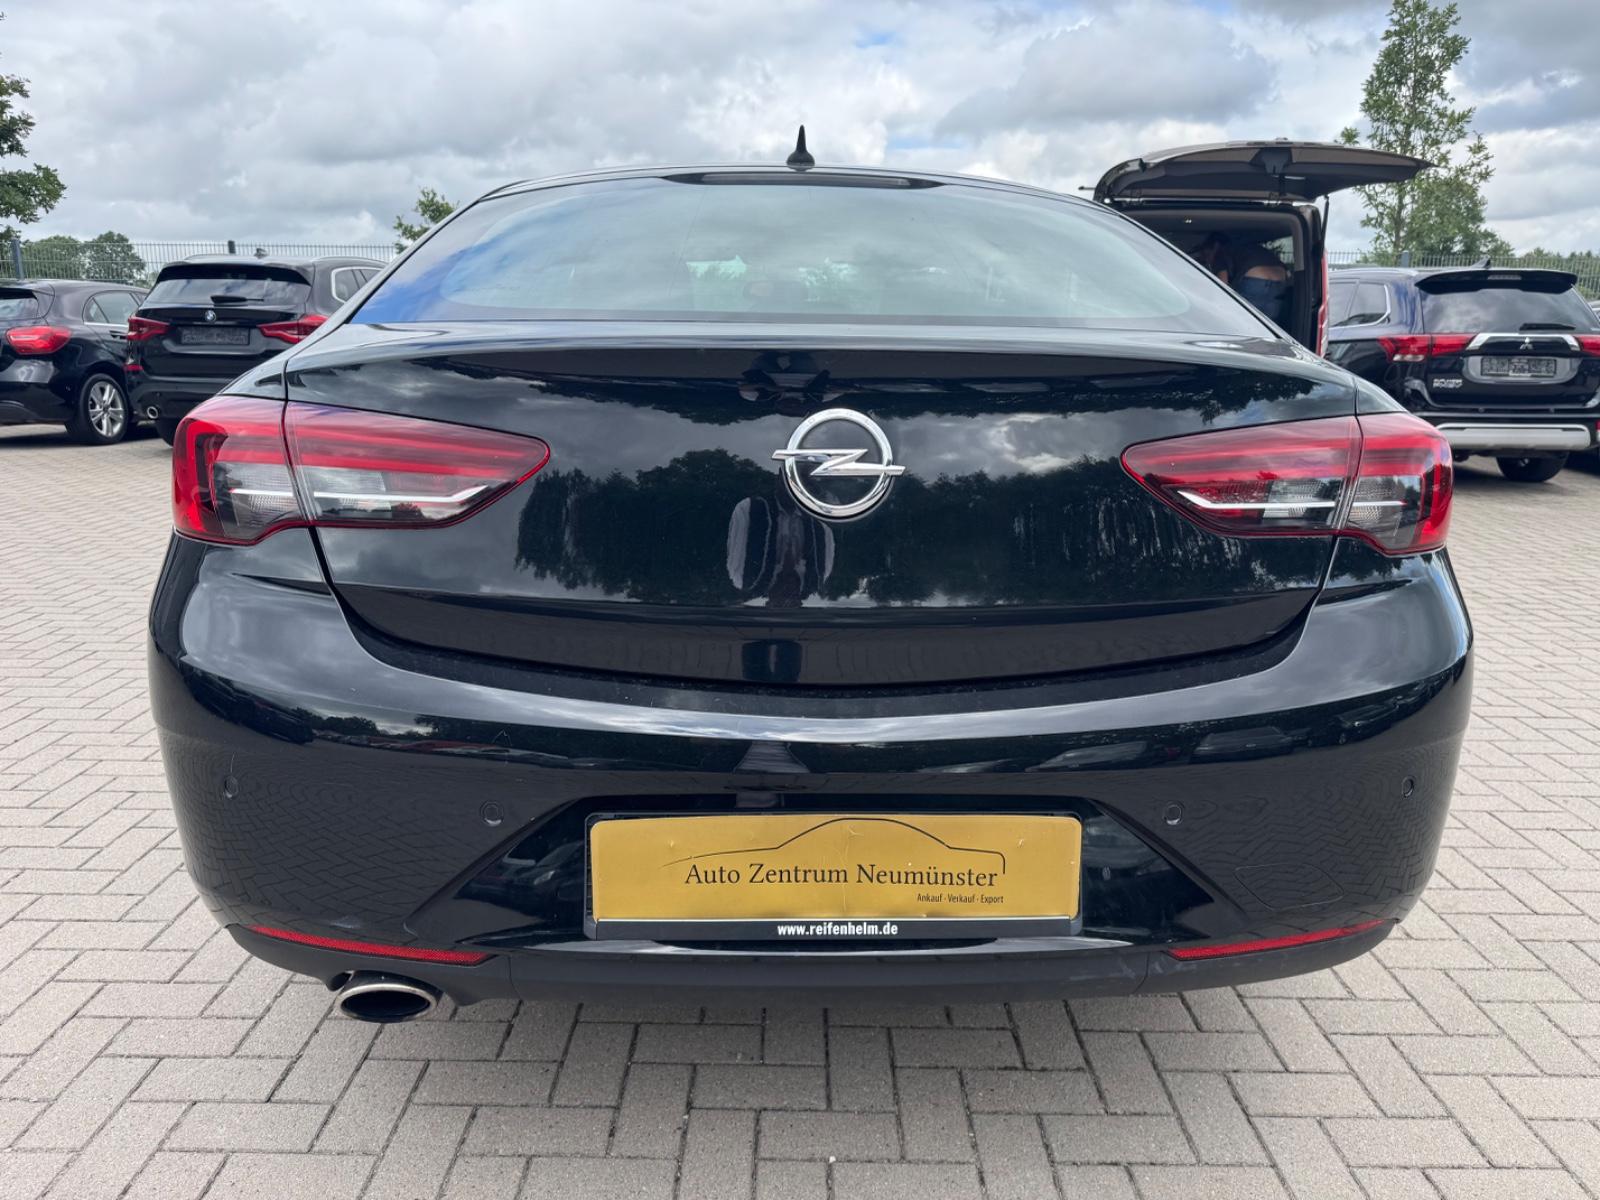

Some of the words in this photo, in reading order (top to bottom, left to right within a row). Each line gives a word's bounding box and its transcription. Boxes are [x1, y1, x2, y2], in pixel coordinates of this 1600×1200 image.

[685, 864, 740, 884] Auto
[749, 863, 848, 884] Zentrum
[856, 864, 998, 886] Neumünster
[917, 893, 942, 903] Ankauf
[947, 894, 975, 904] Verkauf
[980, 894, 1004, 904] Export
[777, 922, 898, 936] www.reifenhelm.de
